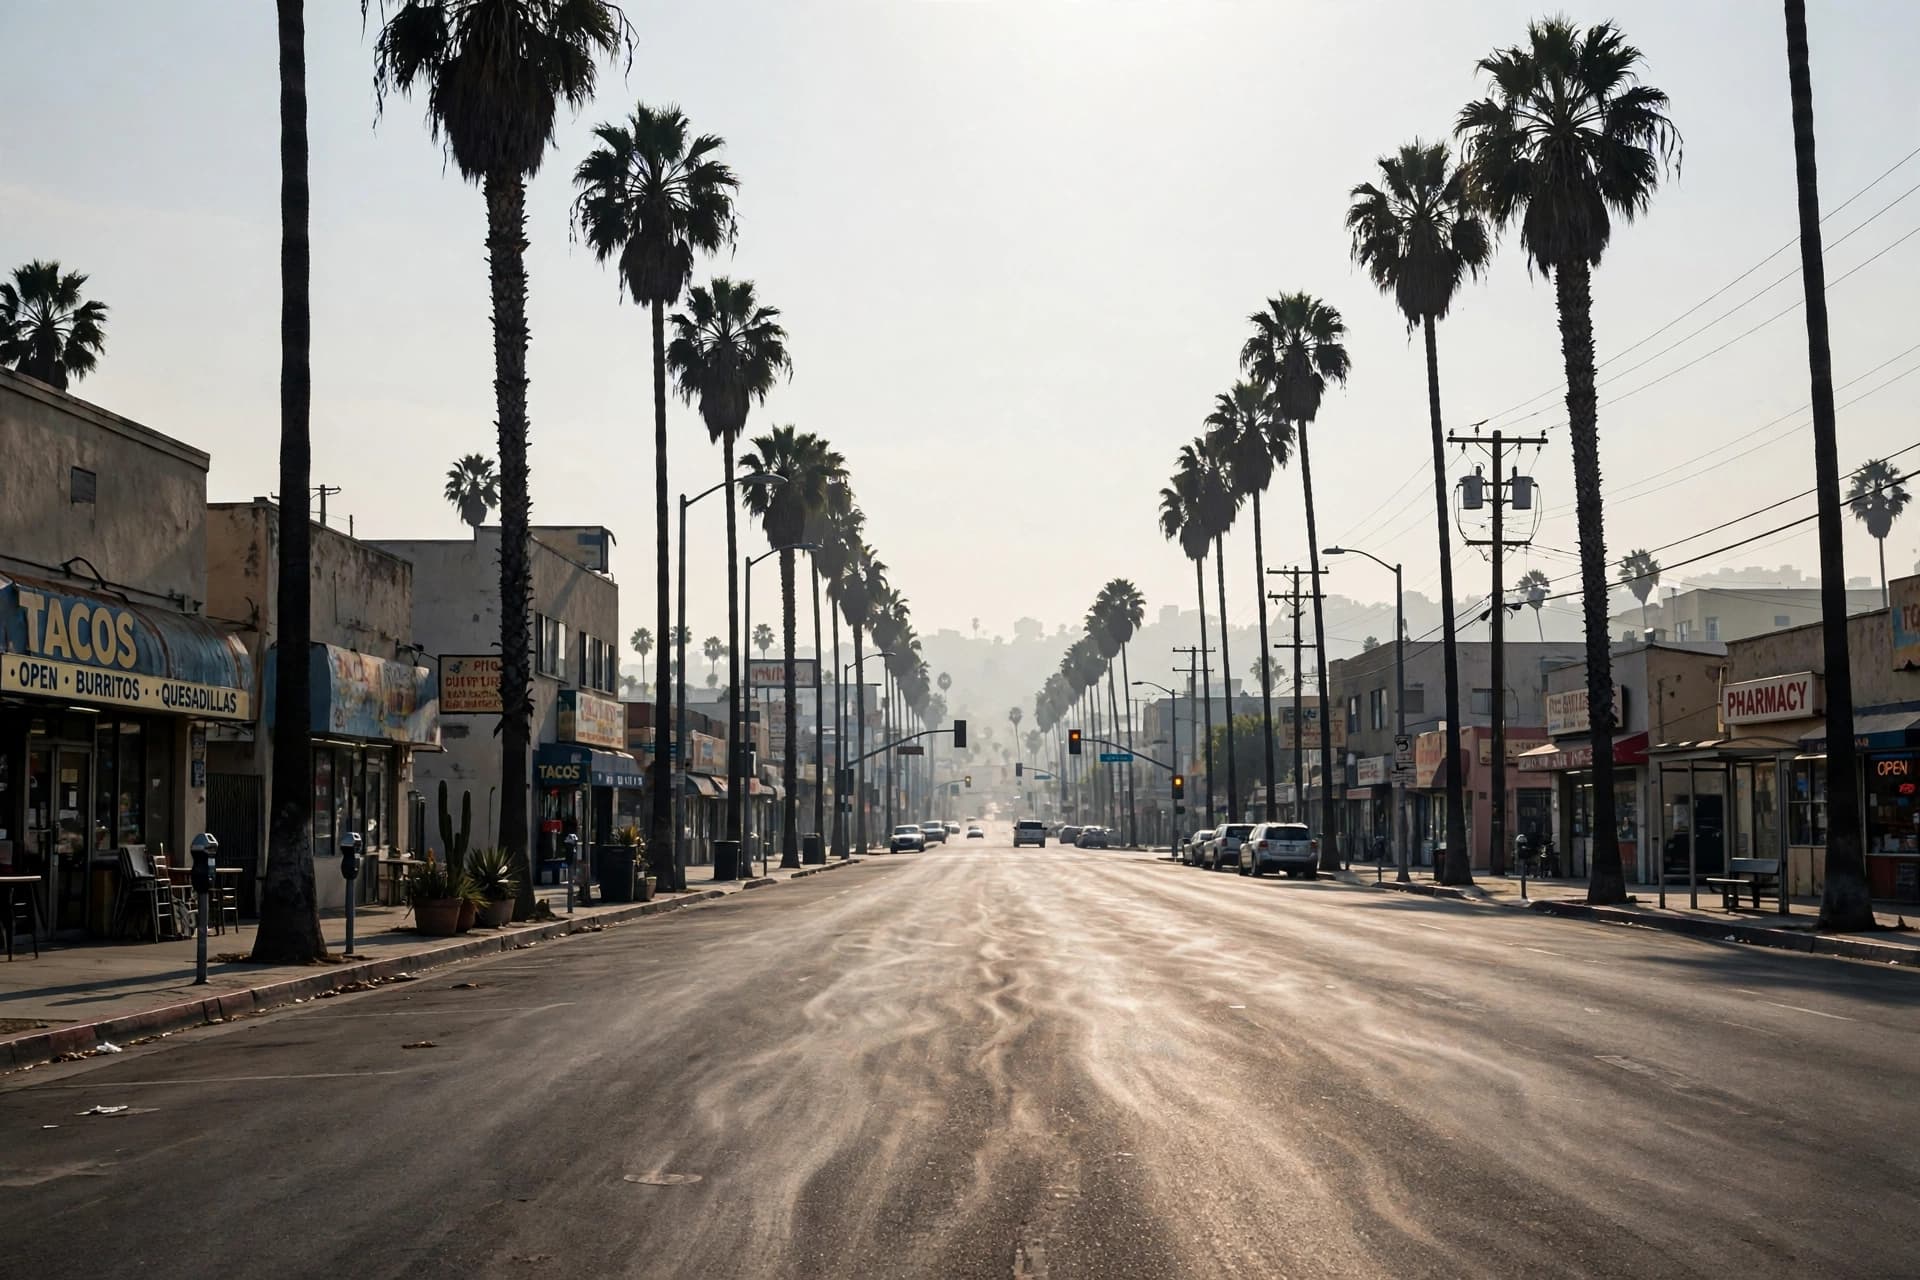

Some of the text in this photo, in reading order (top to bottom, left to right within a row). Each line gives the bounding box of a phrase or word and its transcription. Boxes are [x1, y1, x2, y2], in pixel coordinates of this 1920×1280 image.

[19, 591, 137, 669] TACOS
[19, 661, 237, 714] OPEN BURRITOS QUESADILLAS
[1727, 681, 1807, 717] PHARMACY
[538, 764, 580, 779] TACOS
[1877, 760, 1908, 776] OPEN
